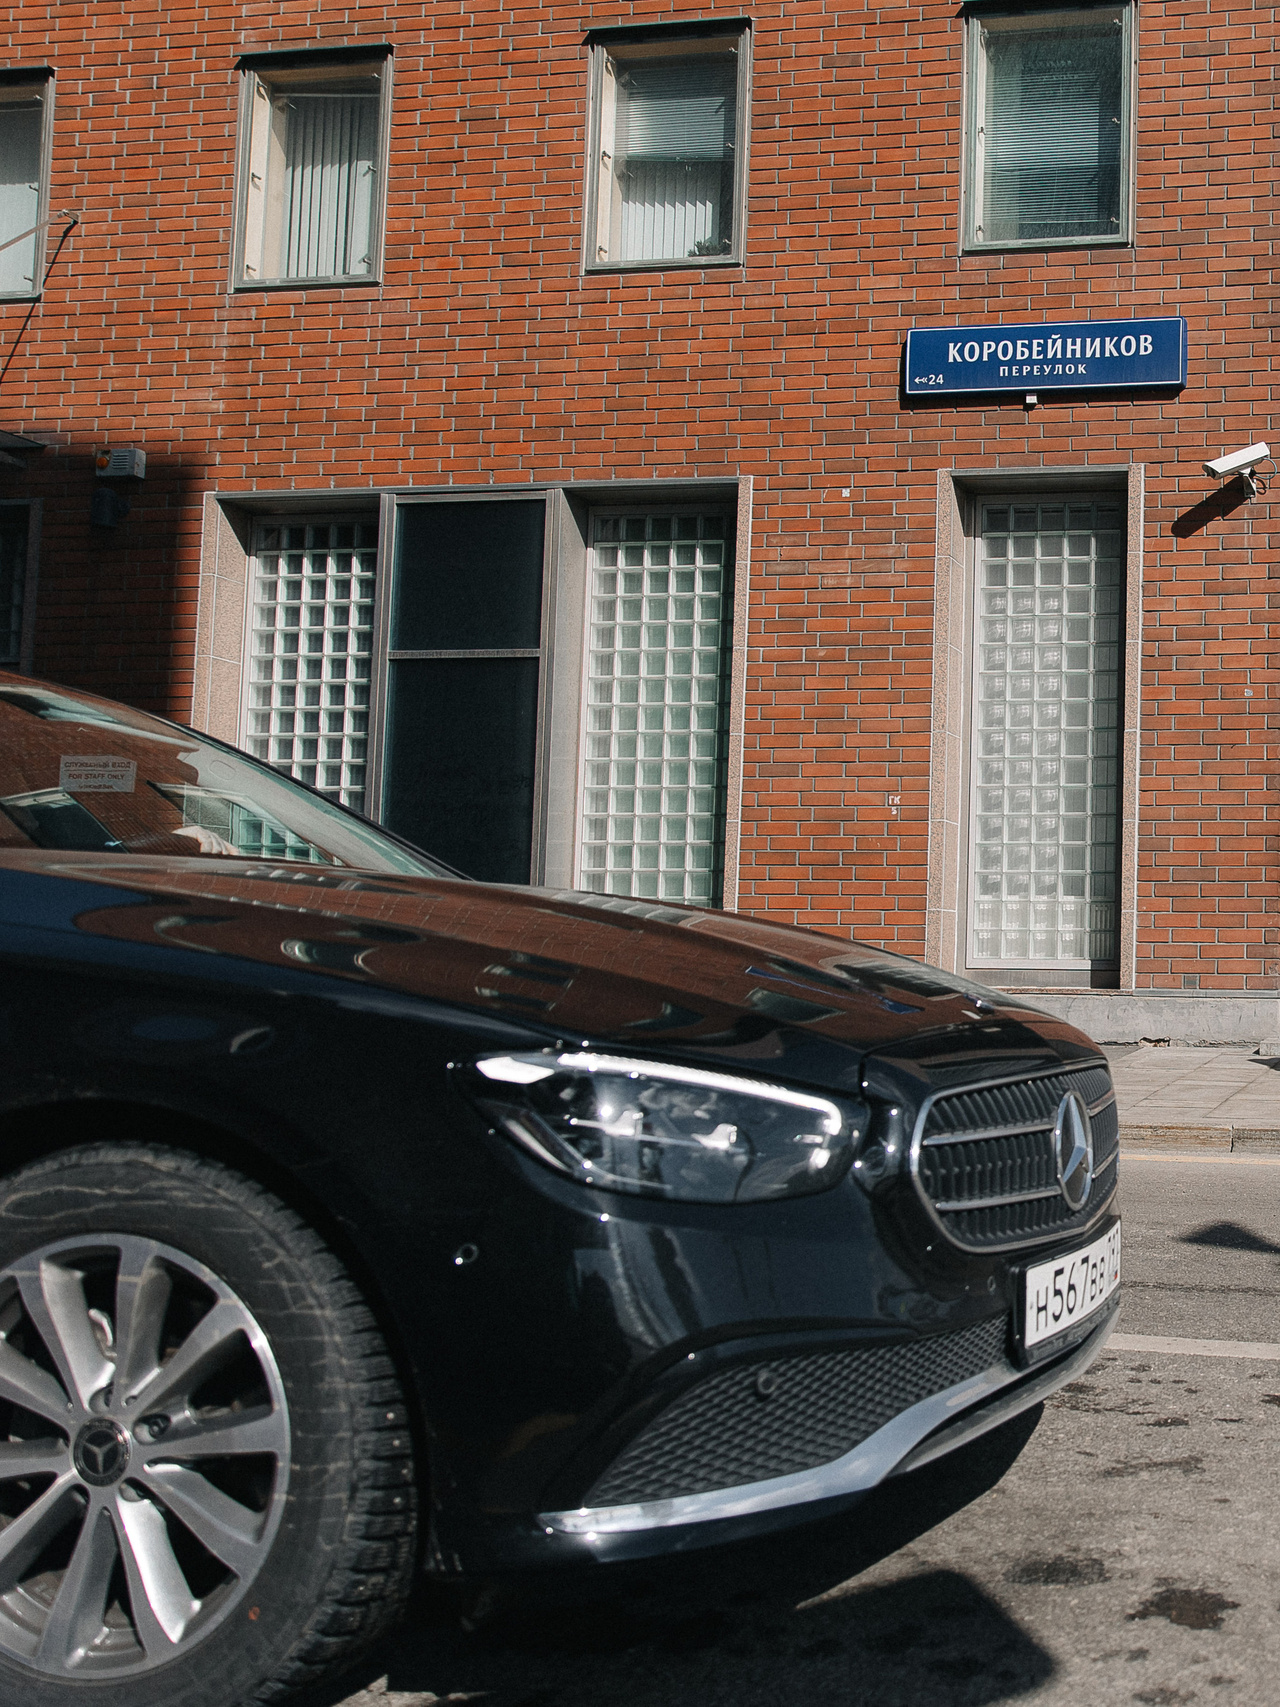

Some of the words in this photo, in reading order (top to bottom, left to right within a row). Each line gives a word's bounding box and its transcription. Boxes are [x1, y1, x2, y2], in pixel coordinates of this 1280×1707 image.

[948, 334, 1153, 363] КОРОБЕЙНИКОВ
[1000, 363, 1087, 377] ПЕРЕУЛОК
[928, 374, 944, 385] 24
